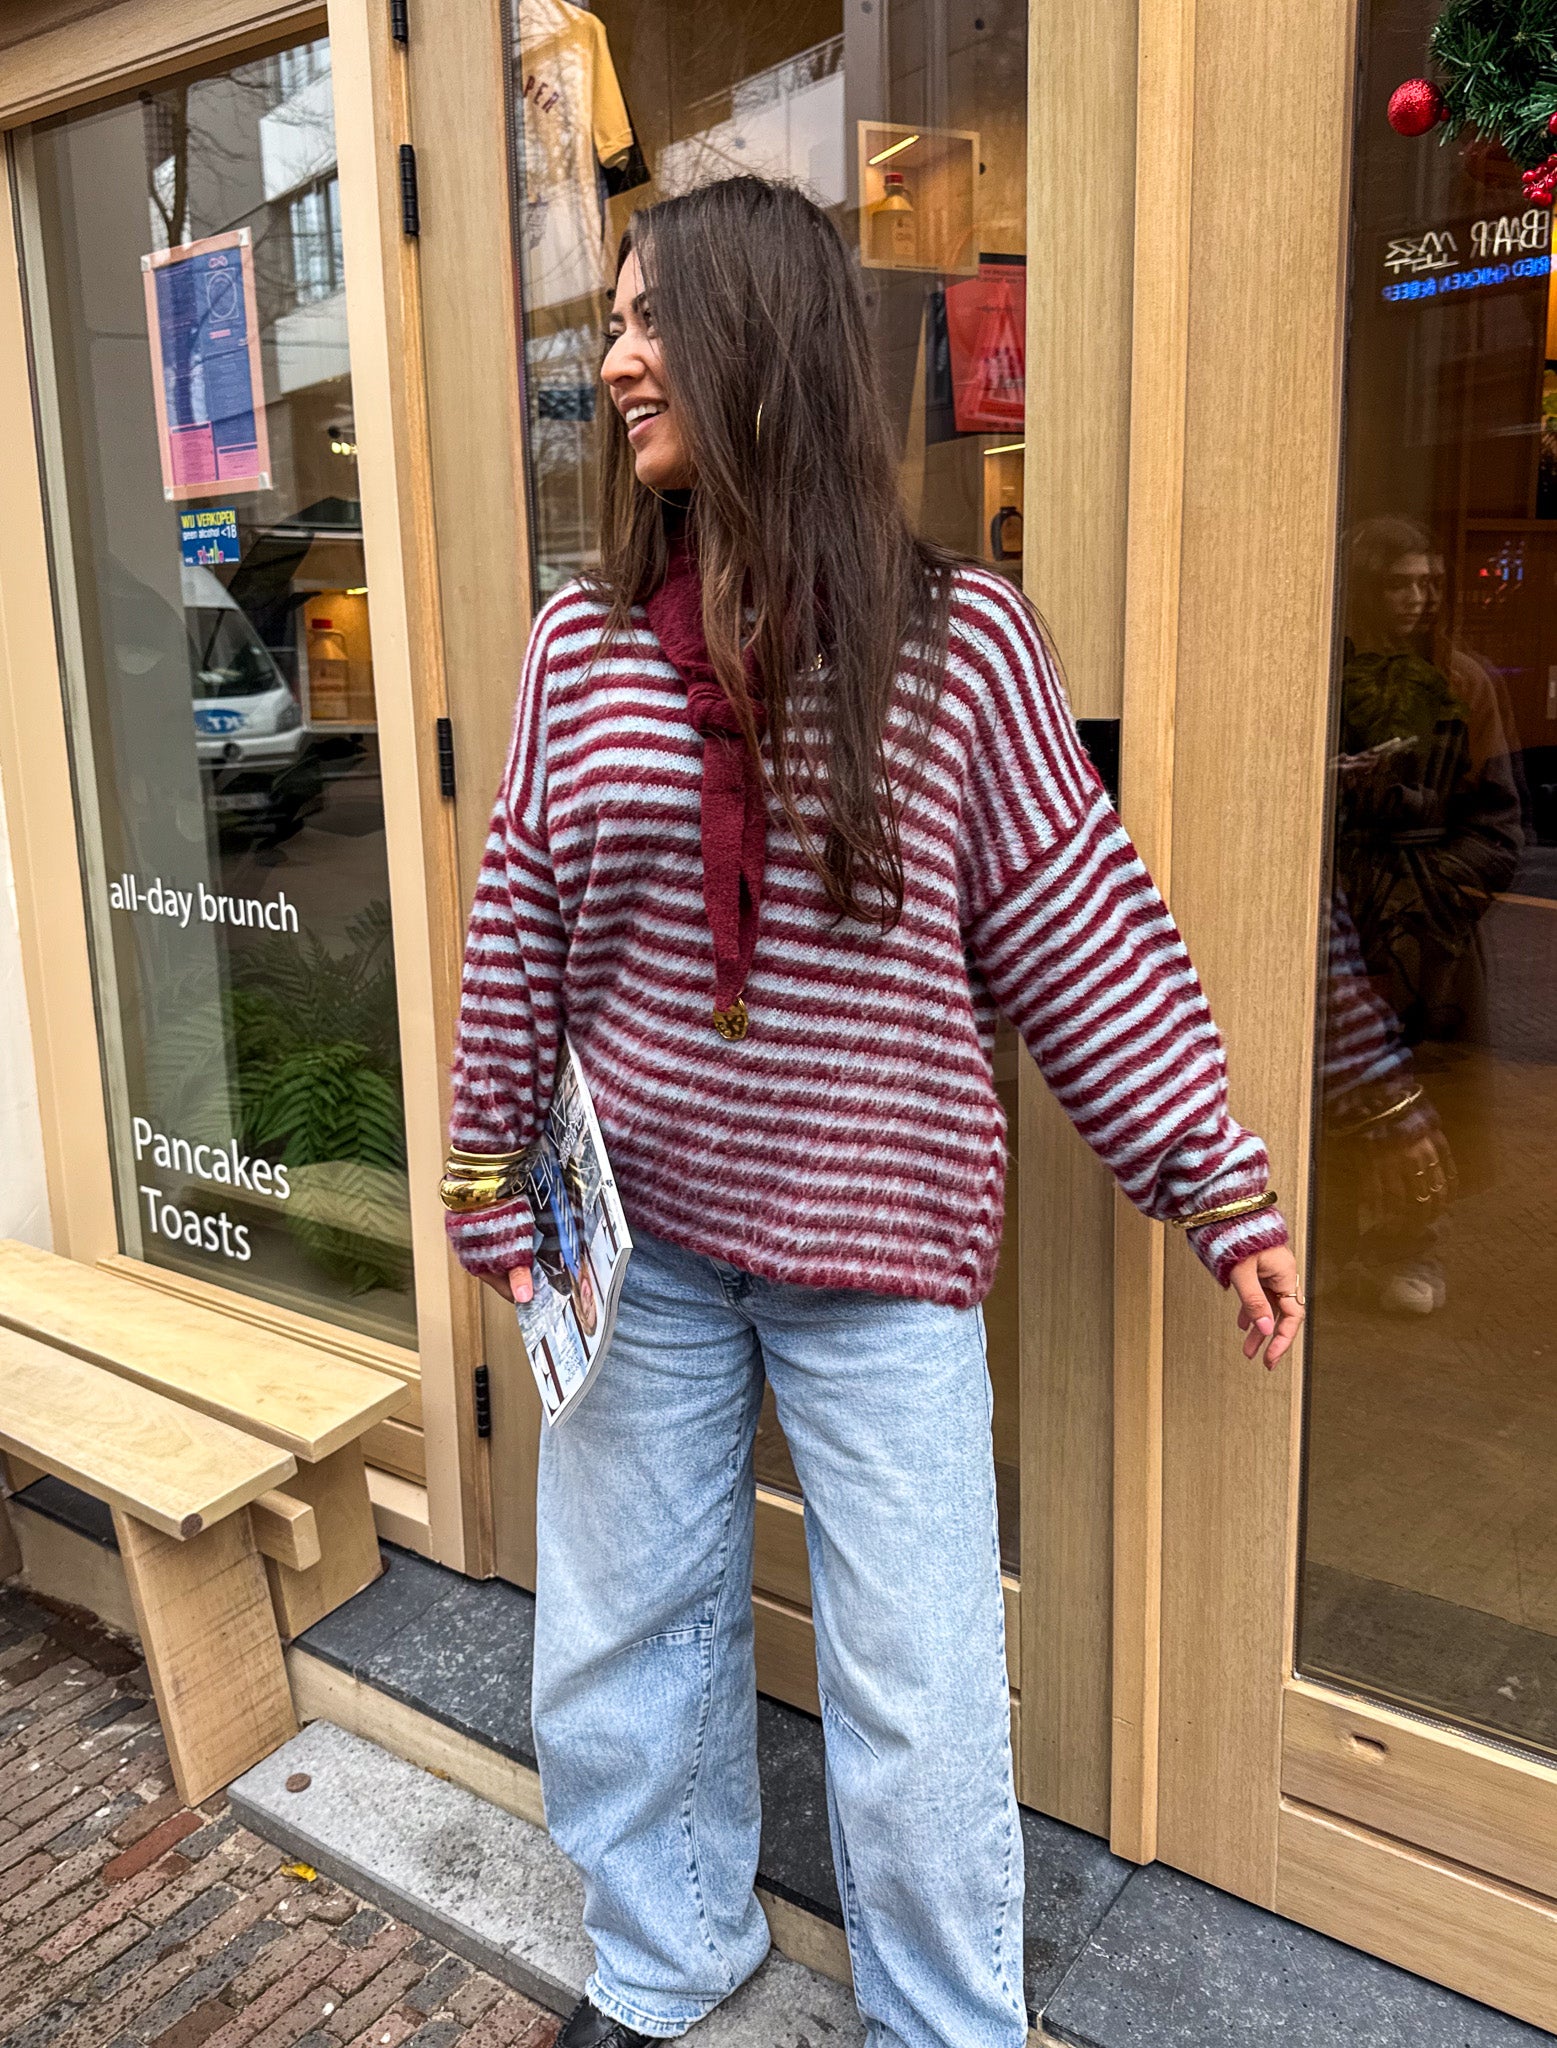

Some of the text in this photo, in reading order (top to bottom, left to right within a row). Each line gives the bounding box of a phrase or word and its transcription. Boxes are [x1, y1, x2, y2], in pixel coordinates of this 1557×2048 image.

[196, 510, 236, 528] VERKOPEN
[110, 873, 300, 934] all-day brunch
[133, 1116, 291, 1200] Pancakes
[140, 1185, 252, 1262] Toasts
